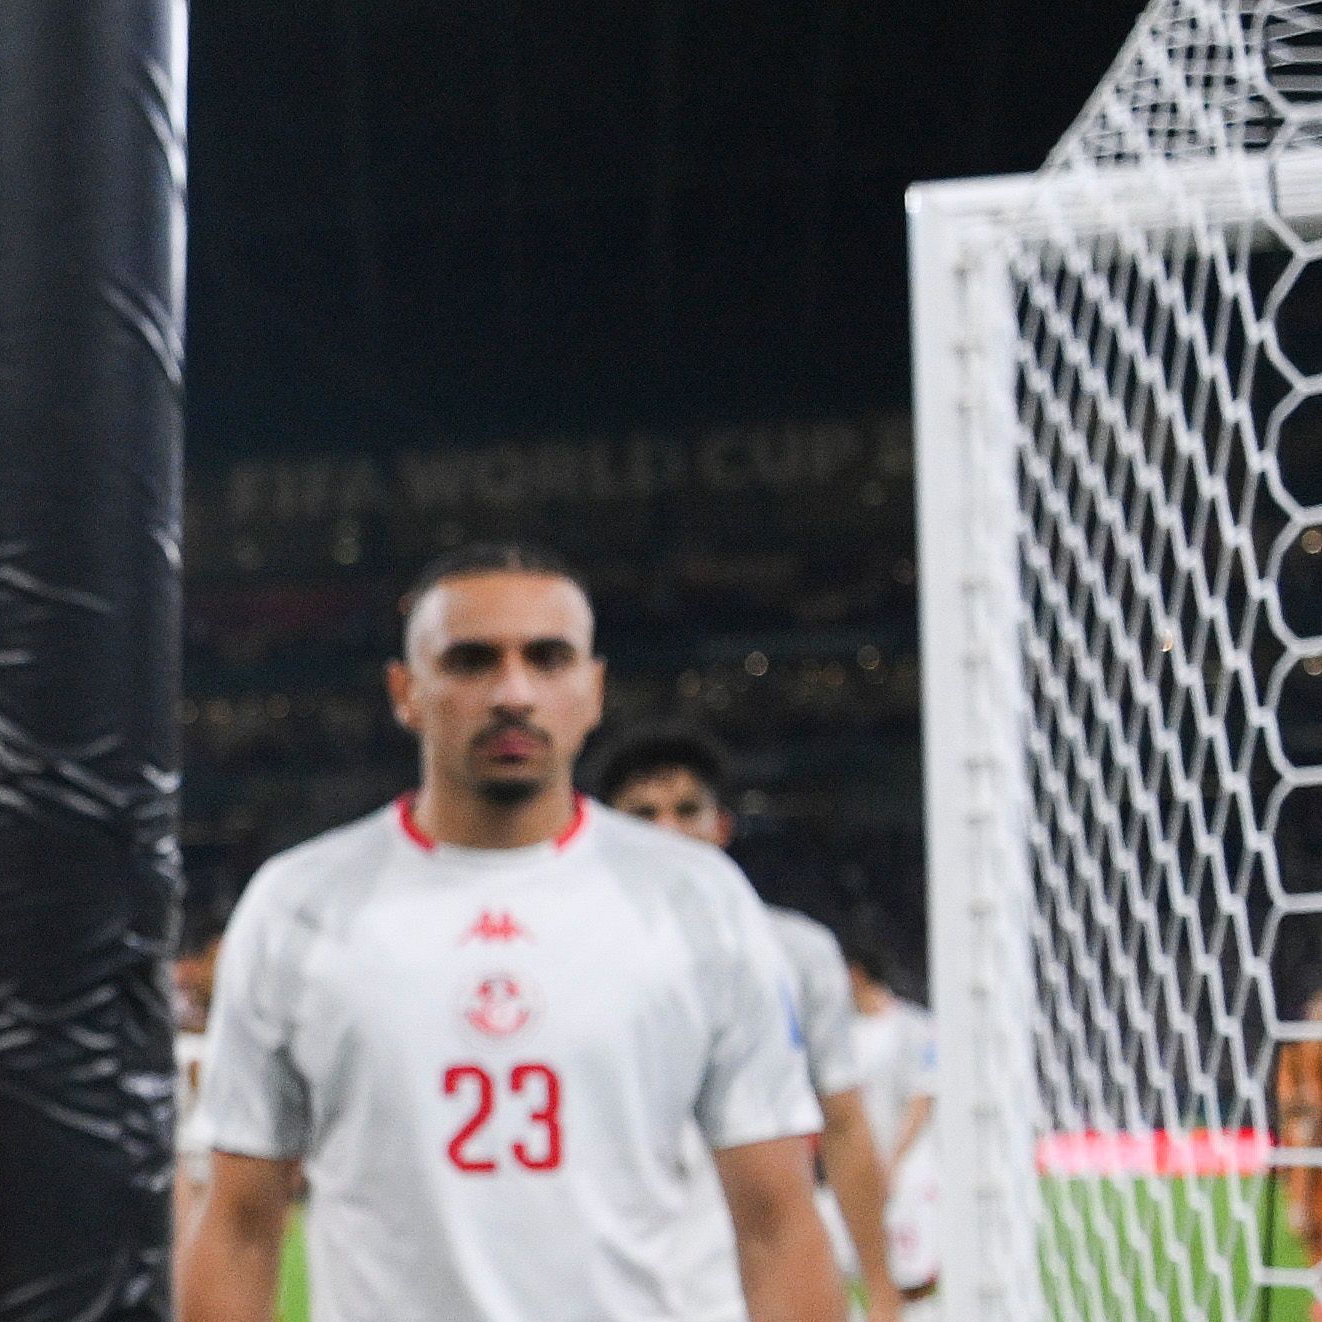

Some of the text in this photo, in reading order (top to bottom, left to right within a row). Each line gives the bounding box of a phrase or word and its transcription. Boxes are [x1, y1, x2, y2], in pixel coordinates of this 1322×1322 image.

[394, 432, 684, 508] WORLD
[697, 420, 864, 491] CUP
[442, 1062, 563, 1173] 23
